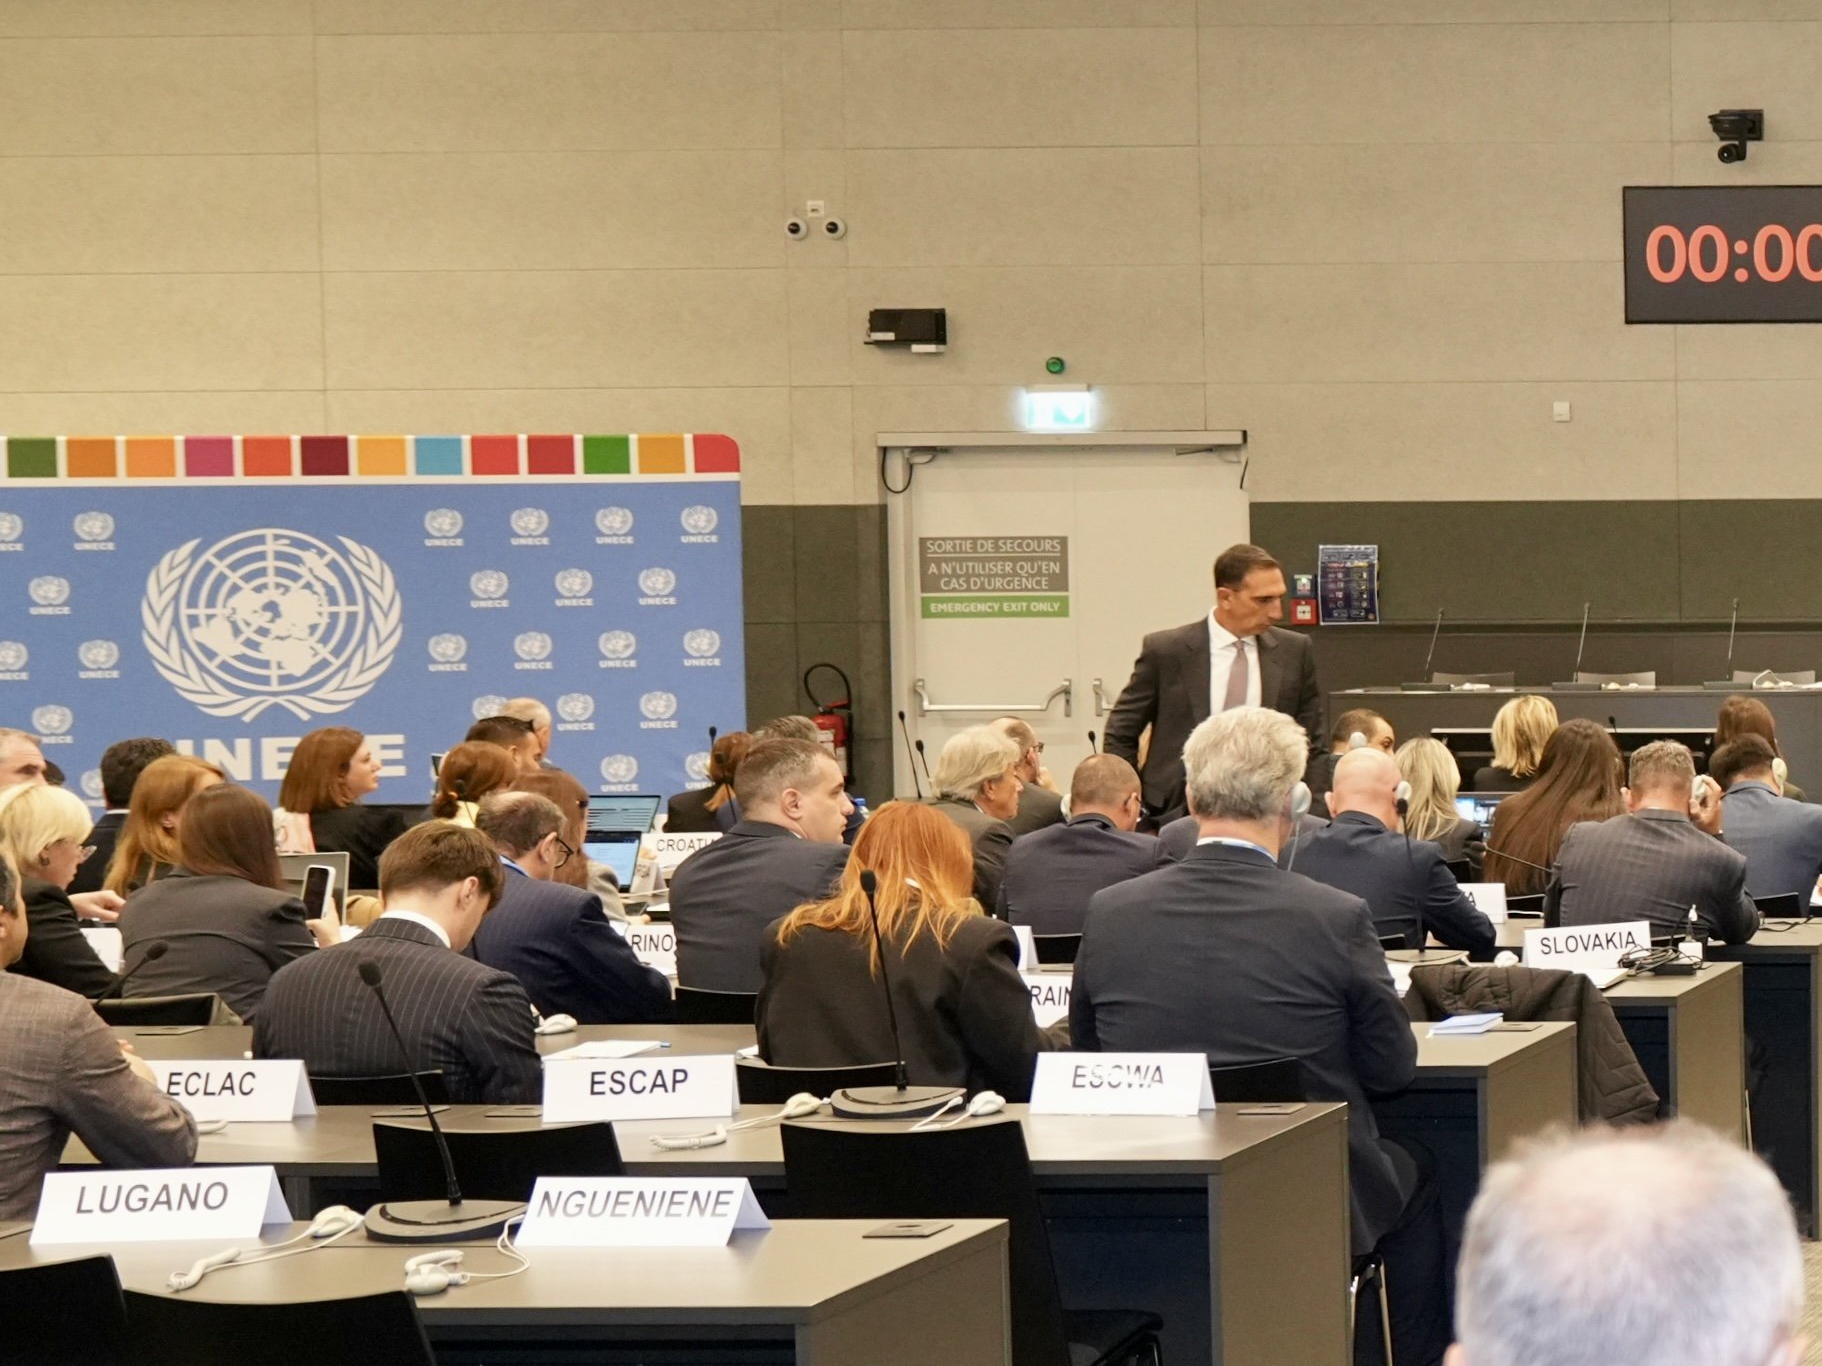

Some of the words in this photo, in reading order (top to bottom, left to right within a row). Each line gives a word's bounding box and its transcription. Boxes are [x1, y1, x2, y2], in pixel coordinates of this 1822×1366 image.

[425, 538, 464, 546] UNECE
[511, 537, 549, 545] UNECE
[596, 536, 634, 544] UNECE
[681, 535, 718, 543] UNECE
[926, 539, 973, 553] SORTIE
[977, 539, 995, 552] DE
[999, 538, 1061, 552] SECOURS
[928, 563, 938, 575] A
[941, 562, 1013, 575] N'UTILISER
[1016, 561, 1060, 576] QU'EN
[940, 577, 967, 590] CAS
[970, 577, 1049, 590] D'URGENCE
[470, 599, 509, 607] UNECE
[555, 598, 593, 606] UNECE
[639, 597, 676, 605] UNECE
[930, 603, 999, 613] EMERGENCY
[1003, 602, 1026, 612] EXIT
[1030, 602, 1060, 611] ONLY
[515, 661, 552, 669] UNECE
[599, 659, 636, 668] UNECE
[684, 658, 721, 666] UNECE
[428, 663, 467, 671] UNECE
[557, 722, 594, 731] UNECE
[640, 720, 678, 729] UNECE
[601, 784, 639, 792] UNECE
[656, 838, 714, 853] CROATI
[631, 934, 674, 952] RINO
[1540, 930, 1636, 955] SLOVAKIA
[1072, 1064, 1165, 1089] ESCWA
[167, 1071, 256, 1097] ECLAC
[589, 1068, 690, 1096] ESCAP
[76, 1180, 229, 1215] LUGANO
[536, 1189, 735, 1219] NGUENIENE
